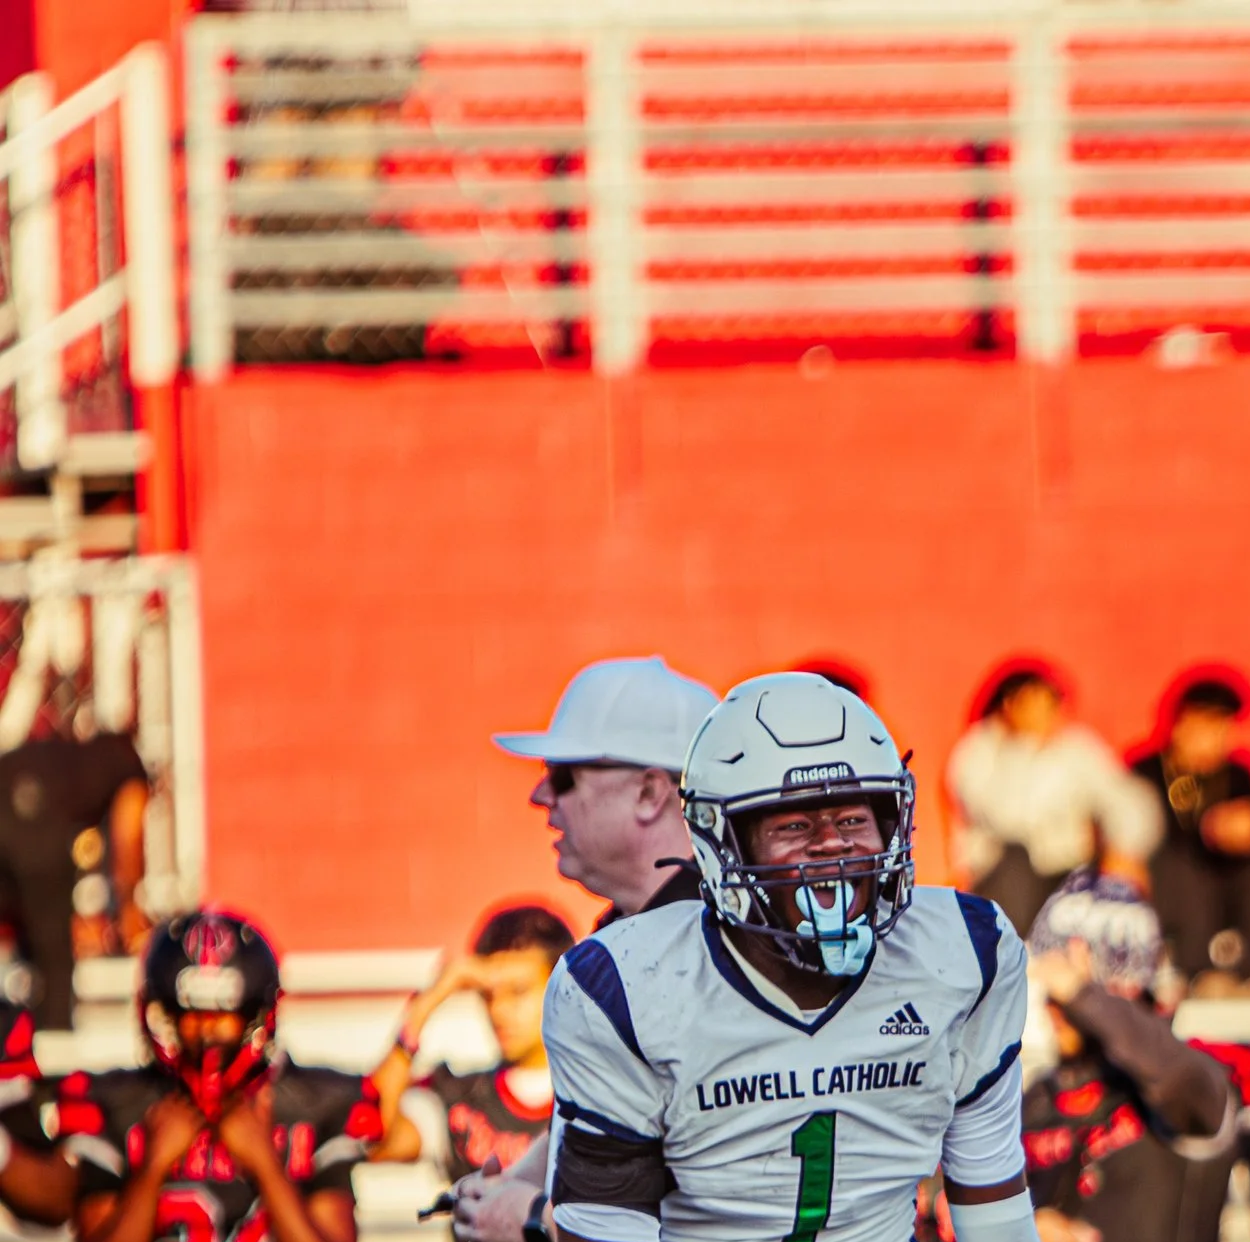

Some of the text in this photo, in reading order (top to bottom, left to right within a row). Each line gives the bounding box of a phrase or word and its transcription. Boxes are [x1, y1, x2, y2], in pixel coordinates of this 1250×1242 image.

[789, 763, 849, 785] Riddell
[878, 1022, 930, 1036] adidas
[695, 1060, 927, 1112] LOWELL CATHOLIC
